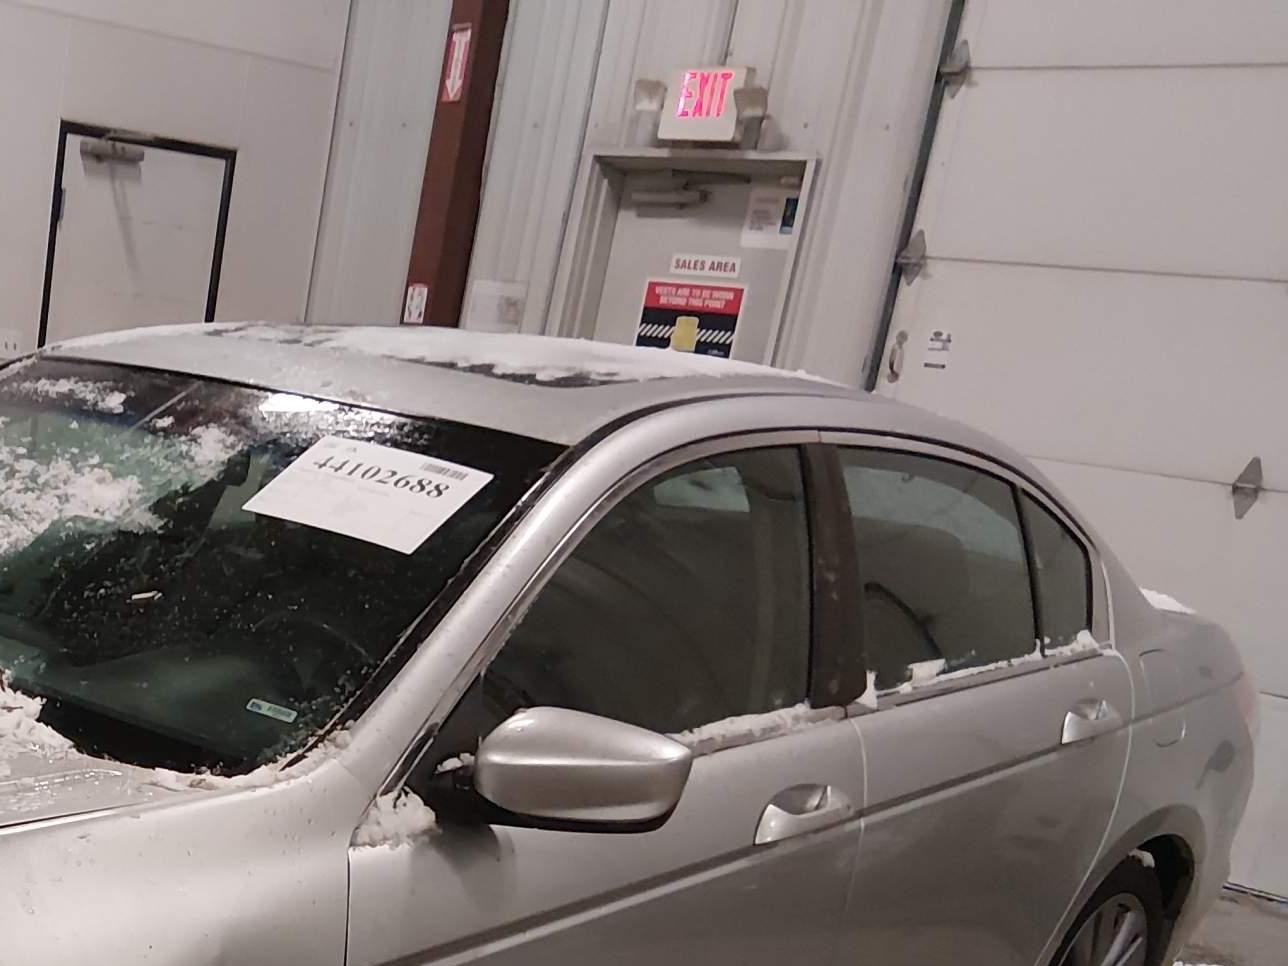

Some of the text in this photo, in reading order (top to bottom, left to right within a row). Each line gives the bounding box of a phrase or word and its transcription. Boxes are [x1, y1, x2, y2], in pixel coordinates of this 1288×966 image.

[677, 71, 733, 118] EXIT
[674, 258, 736, 273] SALES AREA
[313, 455, 450, 499] 44102688
